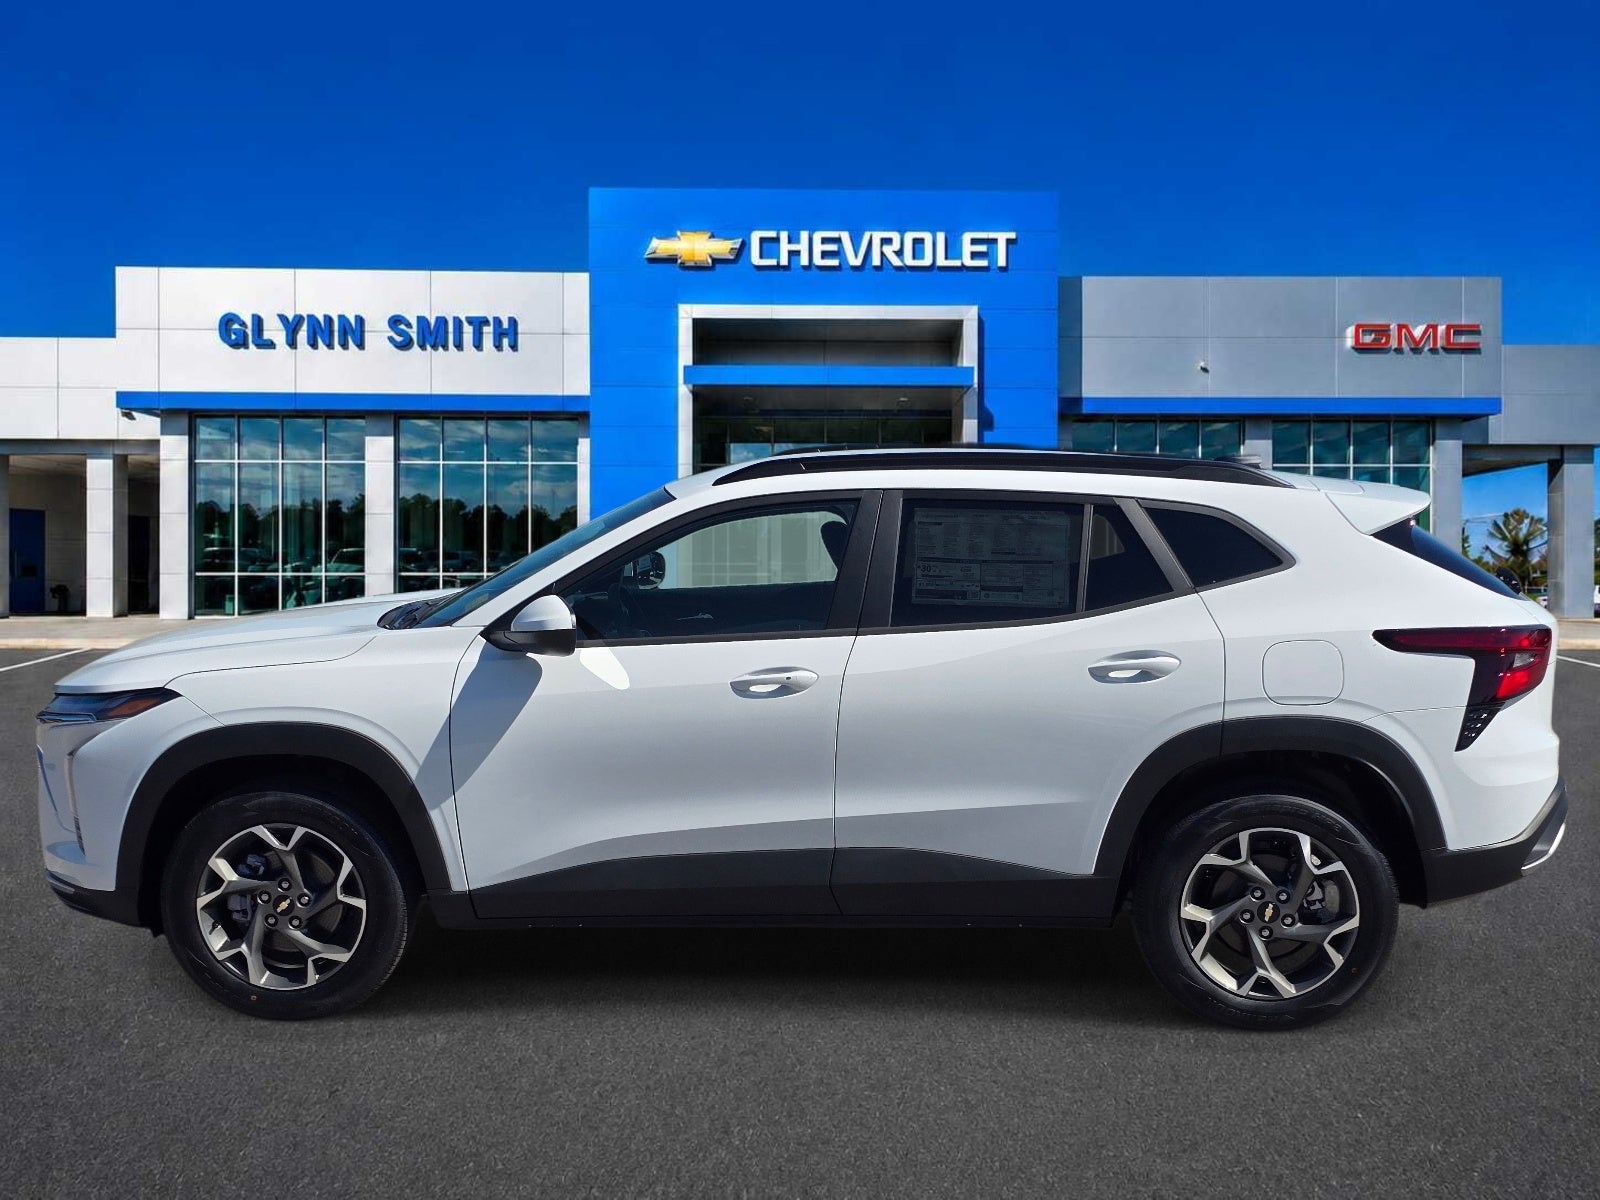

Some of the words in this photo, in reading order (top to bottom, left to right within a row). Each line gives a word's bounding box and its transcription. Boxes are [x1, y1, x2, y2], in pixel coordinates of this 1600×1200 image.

[750, 230, 1017, 269] CHEVROLET
[218, 312, 366, 350] GLYNN
[387, 313, 518, 351] SMITH
[1349, 322, 1482, 352] GMC
